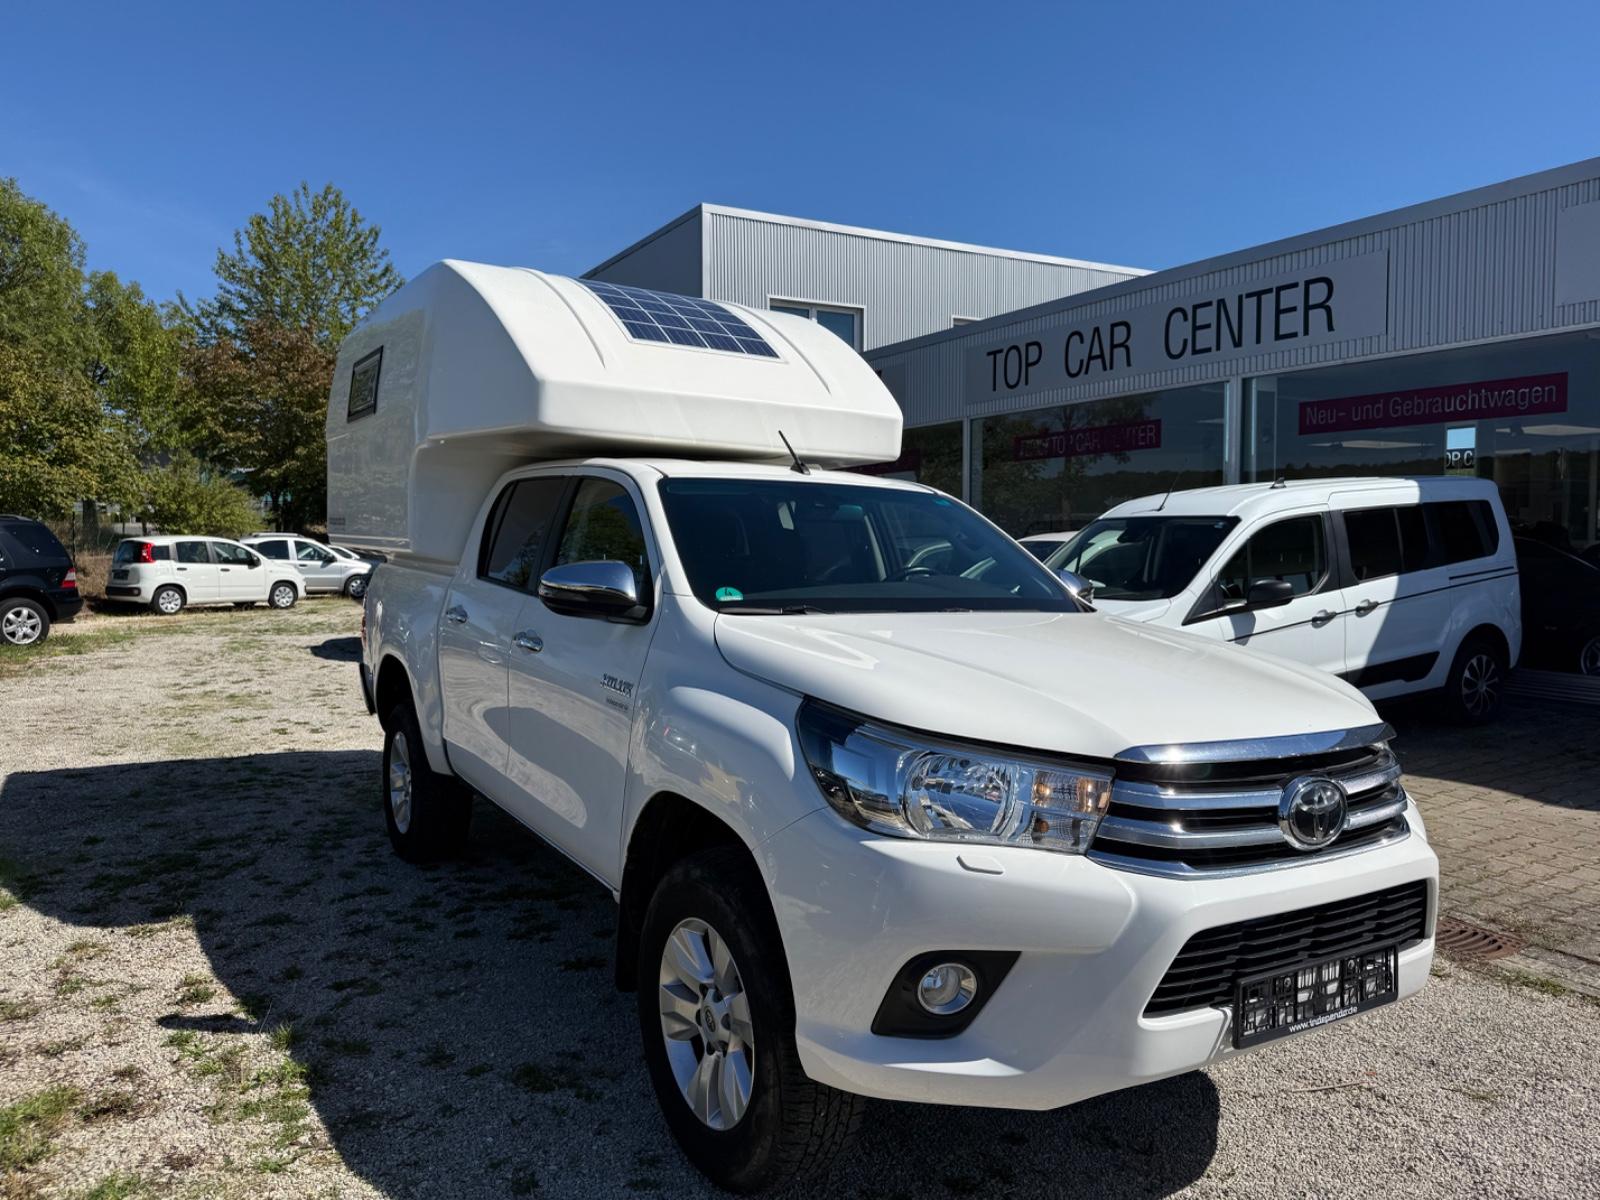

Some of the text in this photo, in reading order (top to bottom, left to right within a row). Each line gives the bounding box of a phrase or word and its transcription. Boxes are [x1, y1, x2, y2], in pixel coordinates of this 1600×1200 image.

[986, 276, 1336, 392] TOP CAR CENTER
[1305, 384, 1557, 426] Neu- und Gebrauchtwagen
